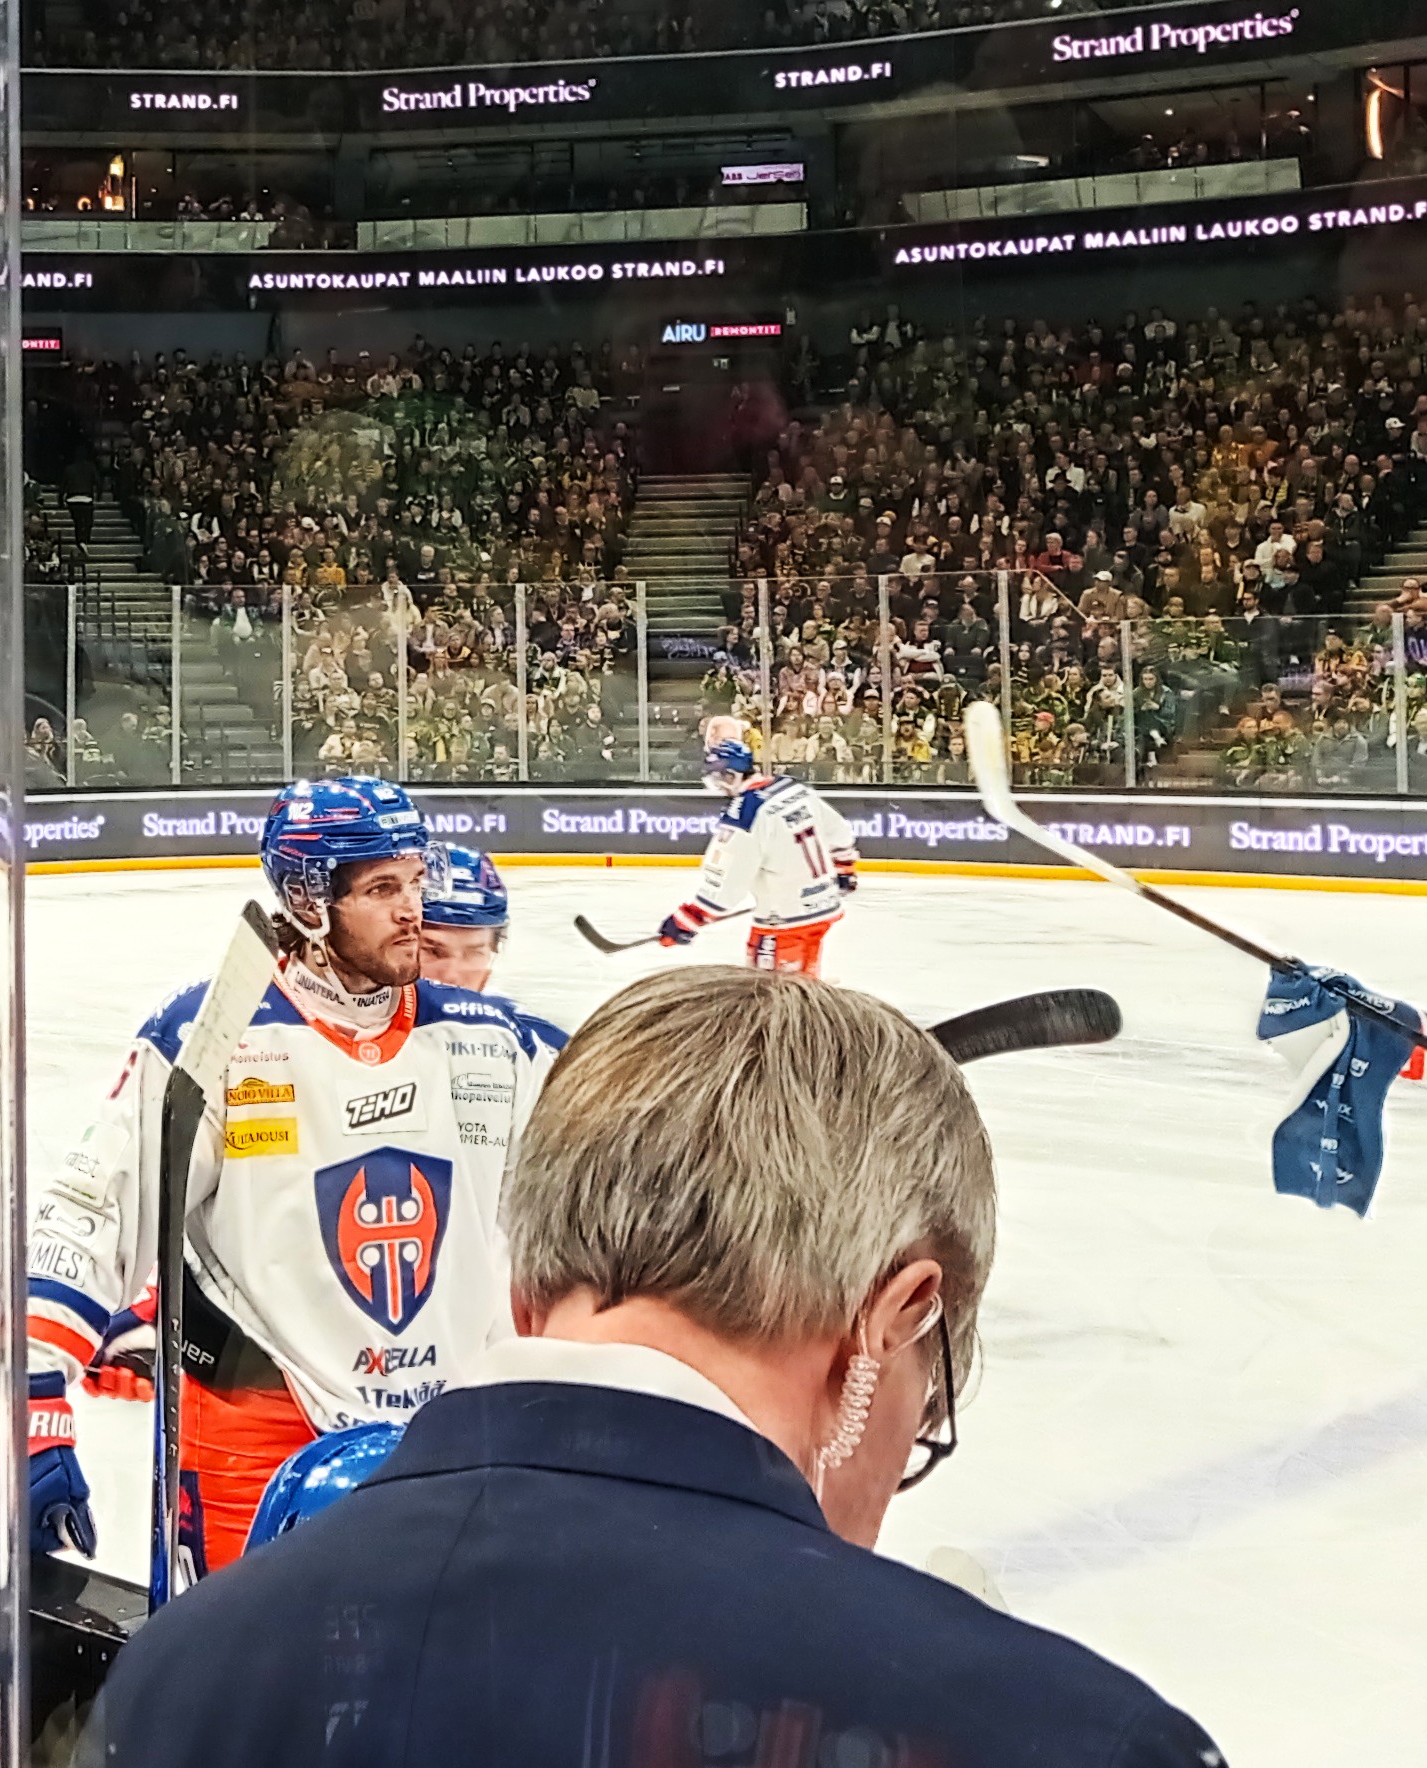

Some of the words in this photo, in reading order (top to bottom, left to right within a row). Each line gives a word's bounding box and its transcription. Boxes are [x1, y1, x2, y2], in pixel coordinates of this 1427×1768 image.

[1052, 25, 1143, 61] Strand
[1150, 13, 1294, 53] Properties
[774, 62, 892, 88] STRAND.FI
[130, 91, 239, 110] STRAND.FI
[382, 84, 463, 112] Strand
[468, 79, 591, 113] Properties
[895, 233, 1076, 265] ASUNTOKAUPAT
[1083, 224, 1187, 251] MAALIIN
[1195, 215, 1300, 243] LAUKOO
[1308, 201, 1427, 231] STRAND.F
[22, 273, 93, 288] AND.FI
[249, 271, 411, 290] ASUNTOKAUPAT
[418, 266, 508, 287] MAALIIN
[515, 263, 605, 282] LAUKOO
[611, 259, 725, 279] STRAND.FI
[22, 339, 56, 349] ONTIT
[714, 325, 777, 337] REMONTIT
[142, 811, 216, 837] Strand
[424, 814, 507, 833] AND.FI
[542, 808, 623, 833] Strand
[627, 809, 721, 841] Propert
[888, 813, 1010, 847] Properties
[1230, 822, 1324, 852] Strand
[458, 1121, 487, 1134] YOTA
